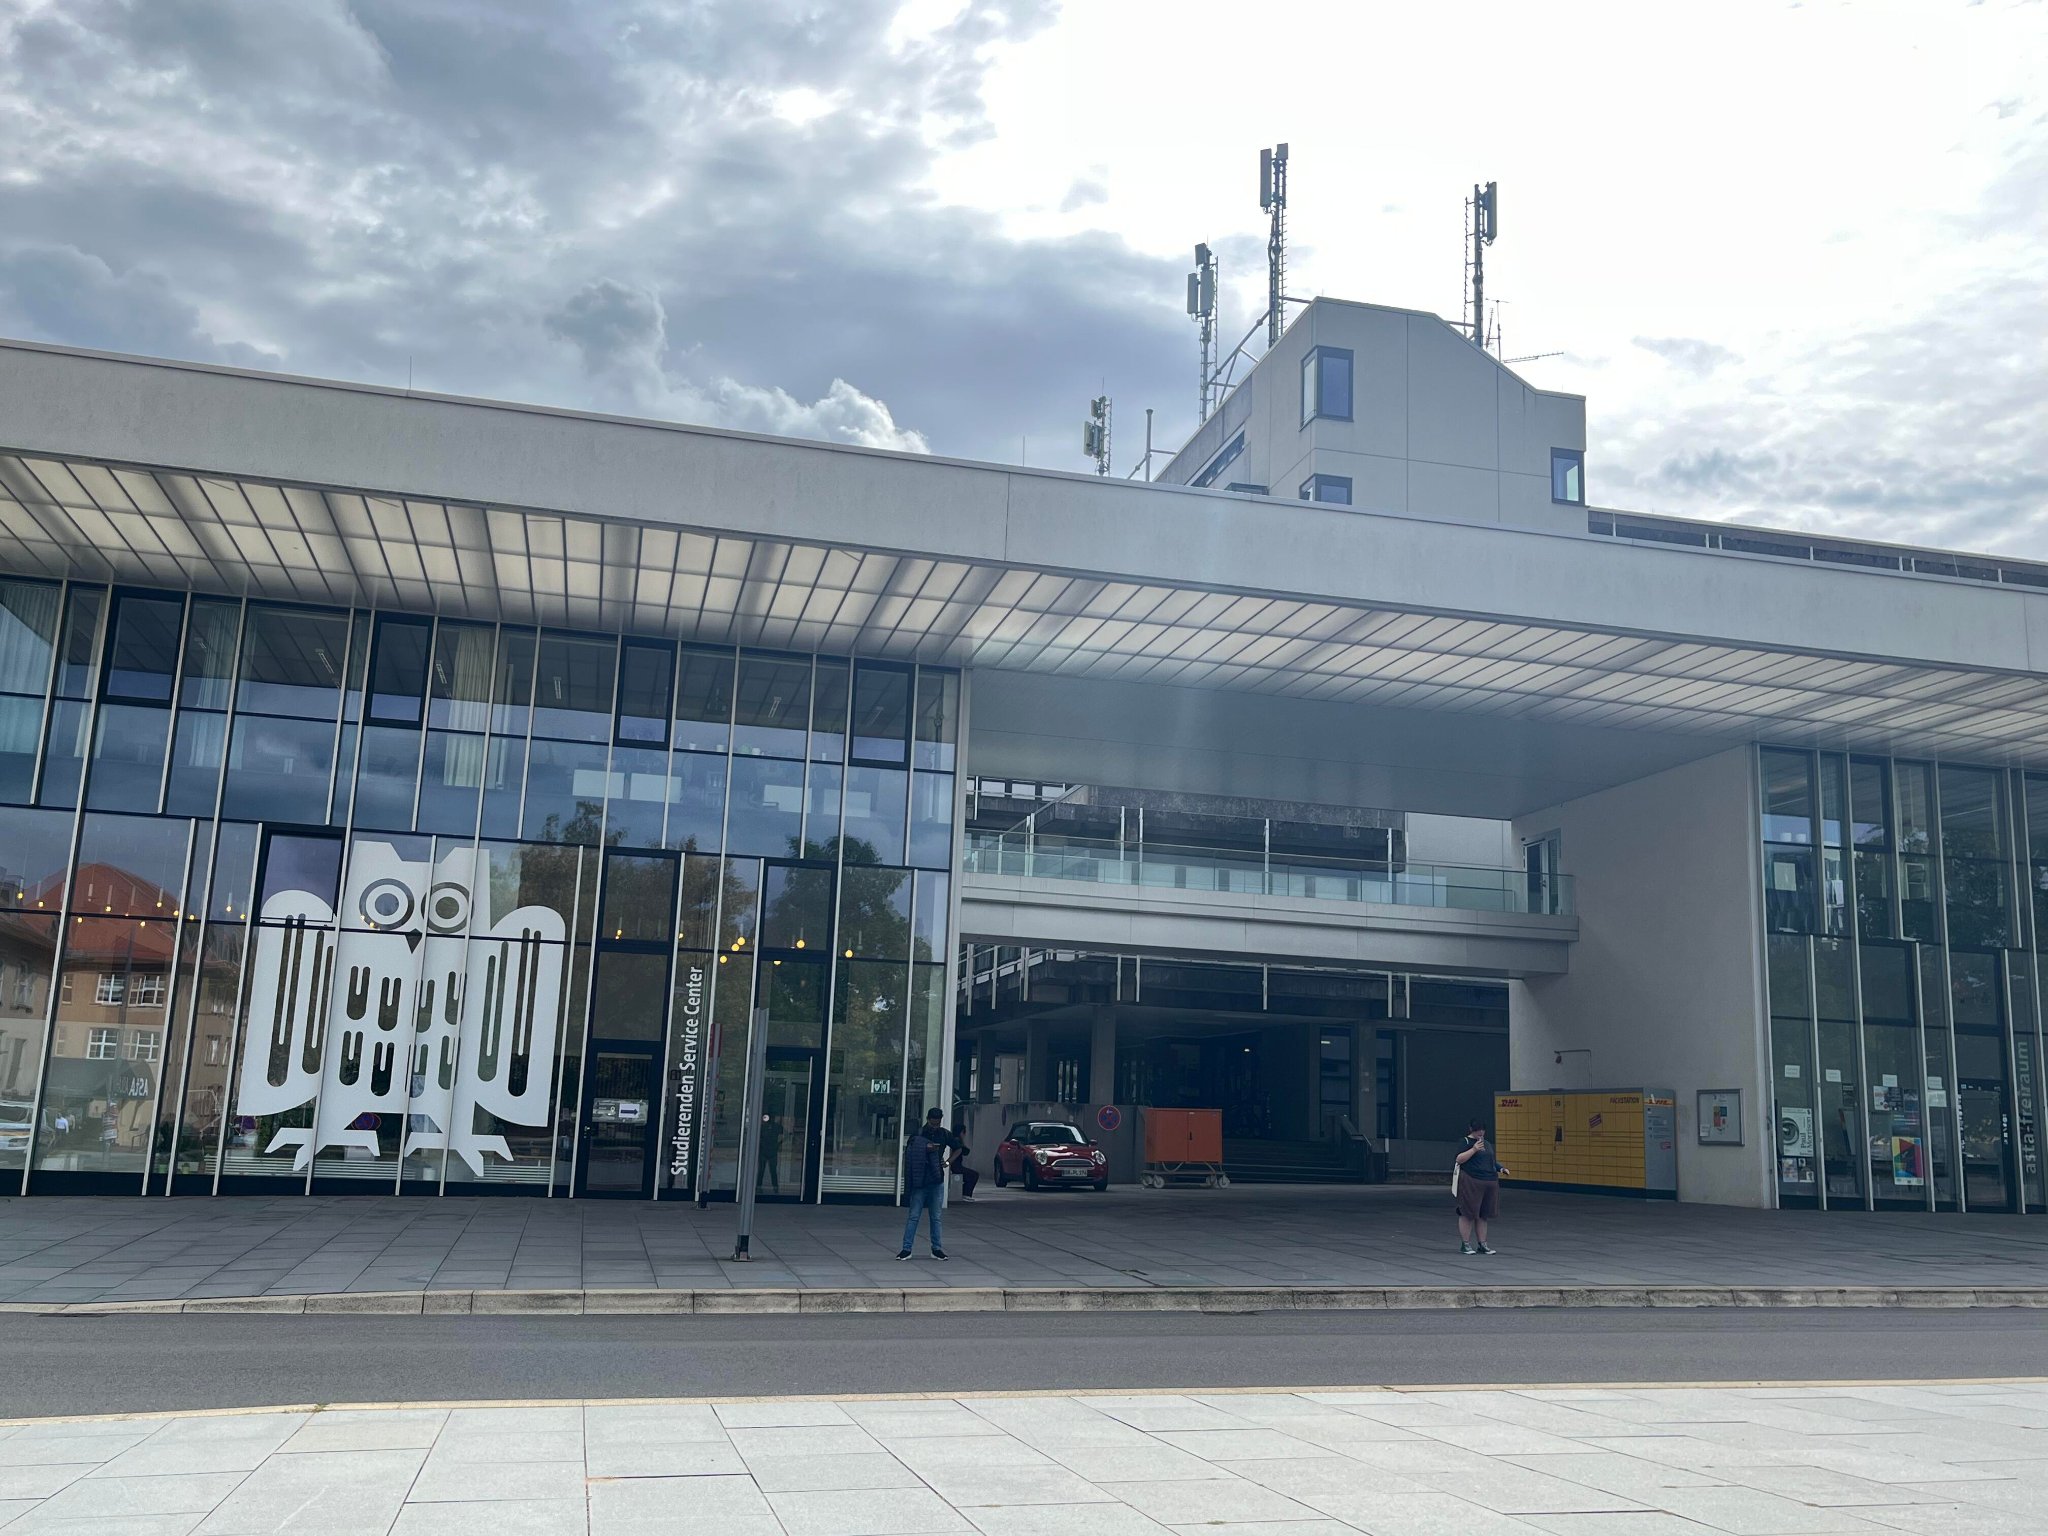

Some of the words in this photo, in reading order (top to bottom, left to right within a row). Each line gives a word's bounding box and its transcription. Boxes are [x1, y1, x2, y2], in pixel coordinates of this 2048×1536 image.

[684, 966, 703, 1015] Center
[679, 1018, 699, 1071] Service
[671, 1075, 695, 1176] Studierenden
[1500, 1098, 1520, 1107] DHL
[1609, 1096, 1640, 1104] PACKSTATION
[2017, 1041, 2037, 1174] asta-freiraum
